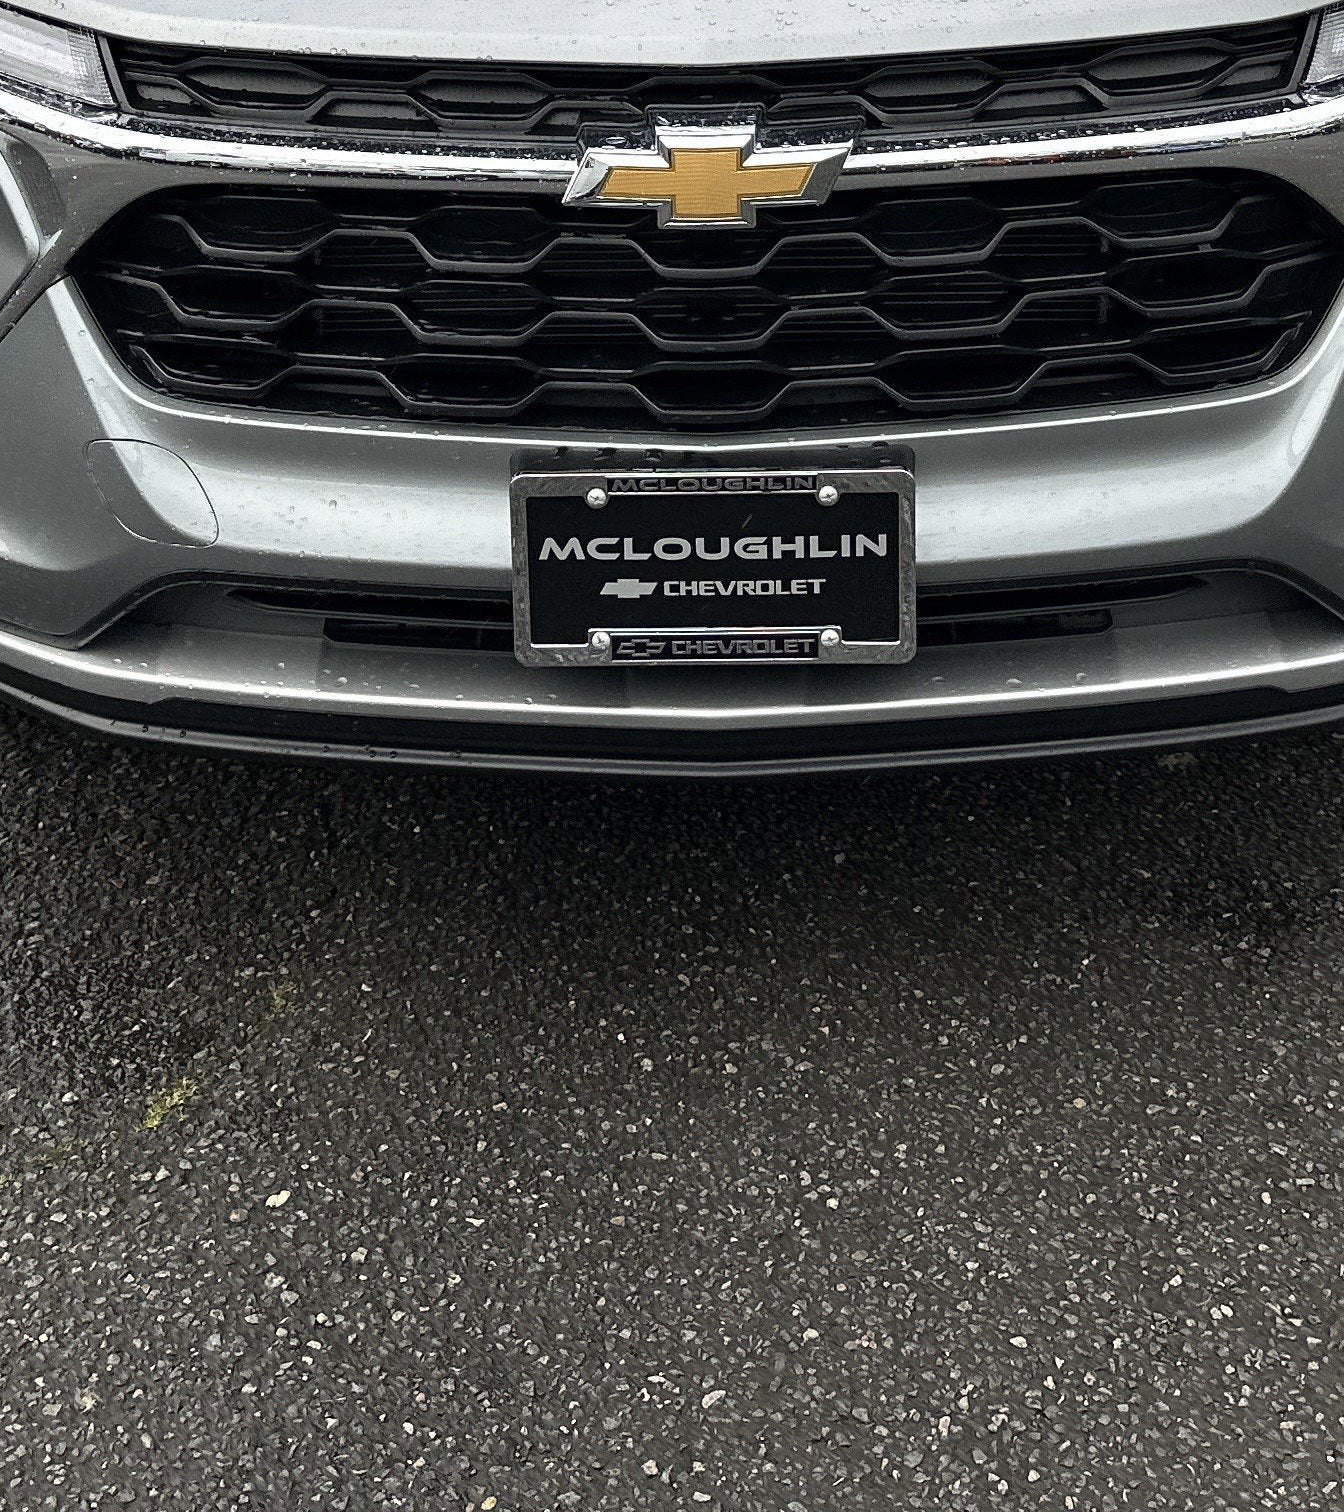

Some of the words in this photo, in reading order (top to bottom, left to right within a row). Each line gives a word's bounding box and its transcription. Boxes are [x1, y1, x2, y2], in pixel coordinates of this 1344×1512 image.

[611, 477, 813, 492] MCLOUGHLIN
[539, 534, 887, 561] MCLOUGHLIN
[663, 578, 827, 597] CHEVROLET
[671, 639, 816, 655] CHEVROLET
